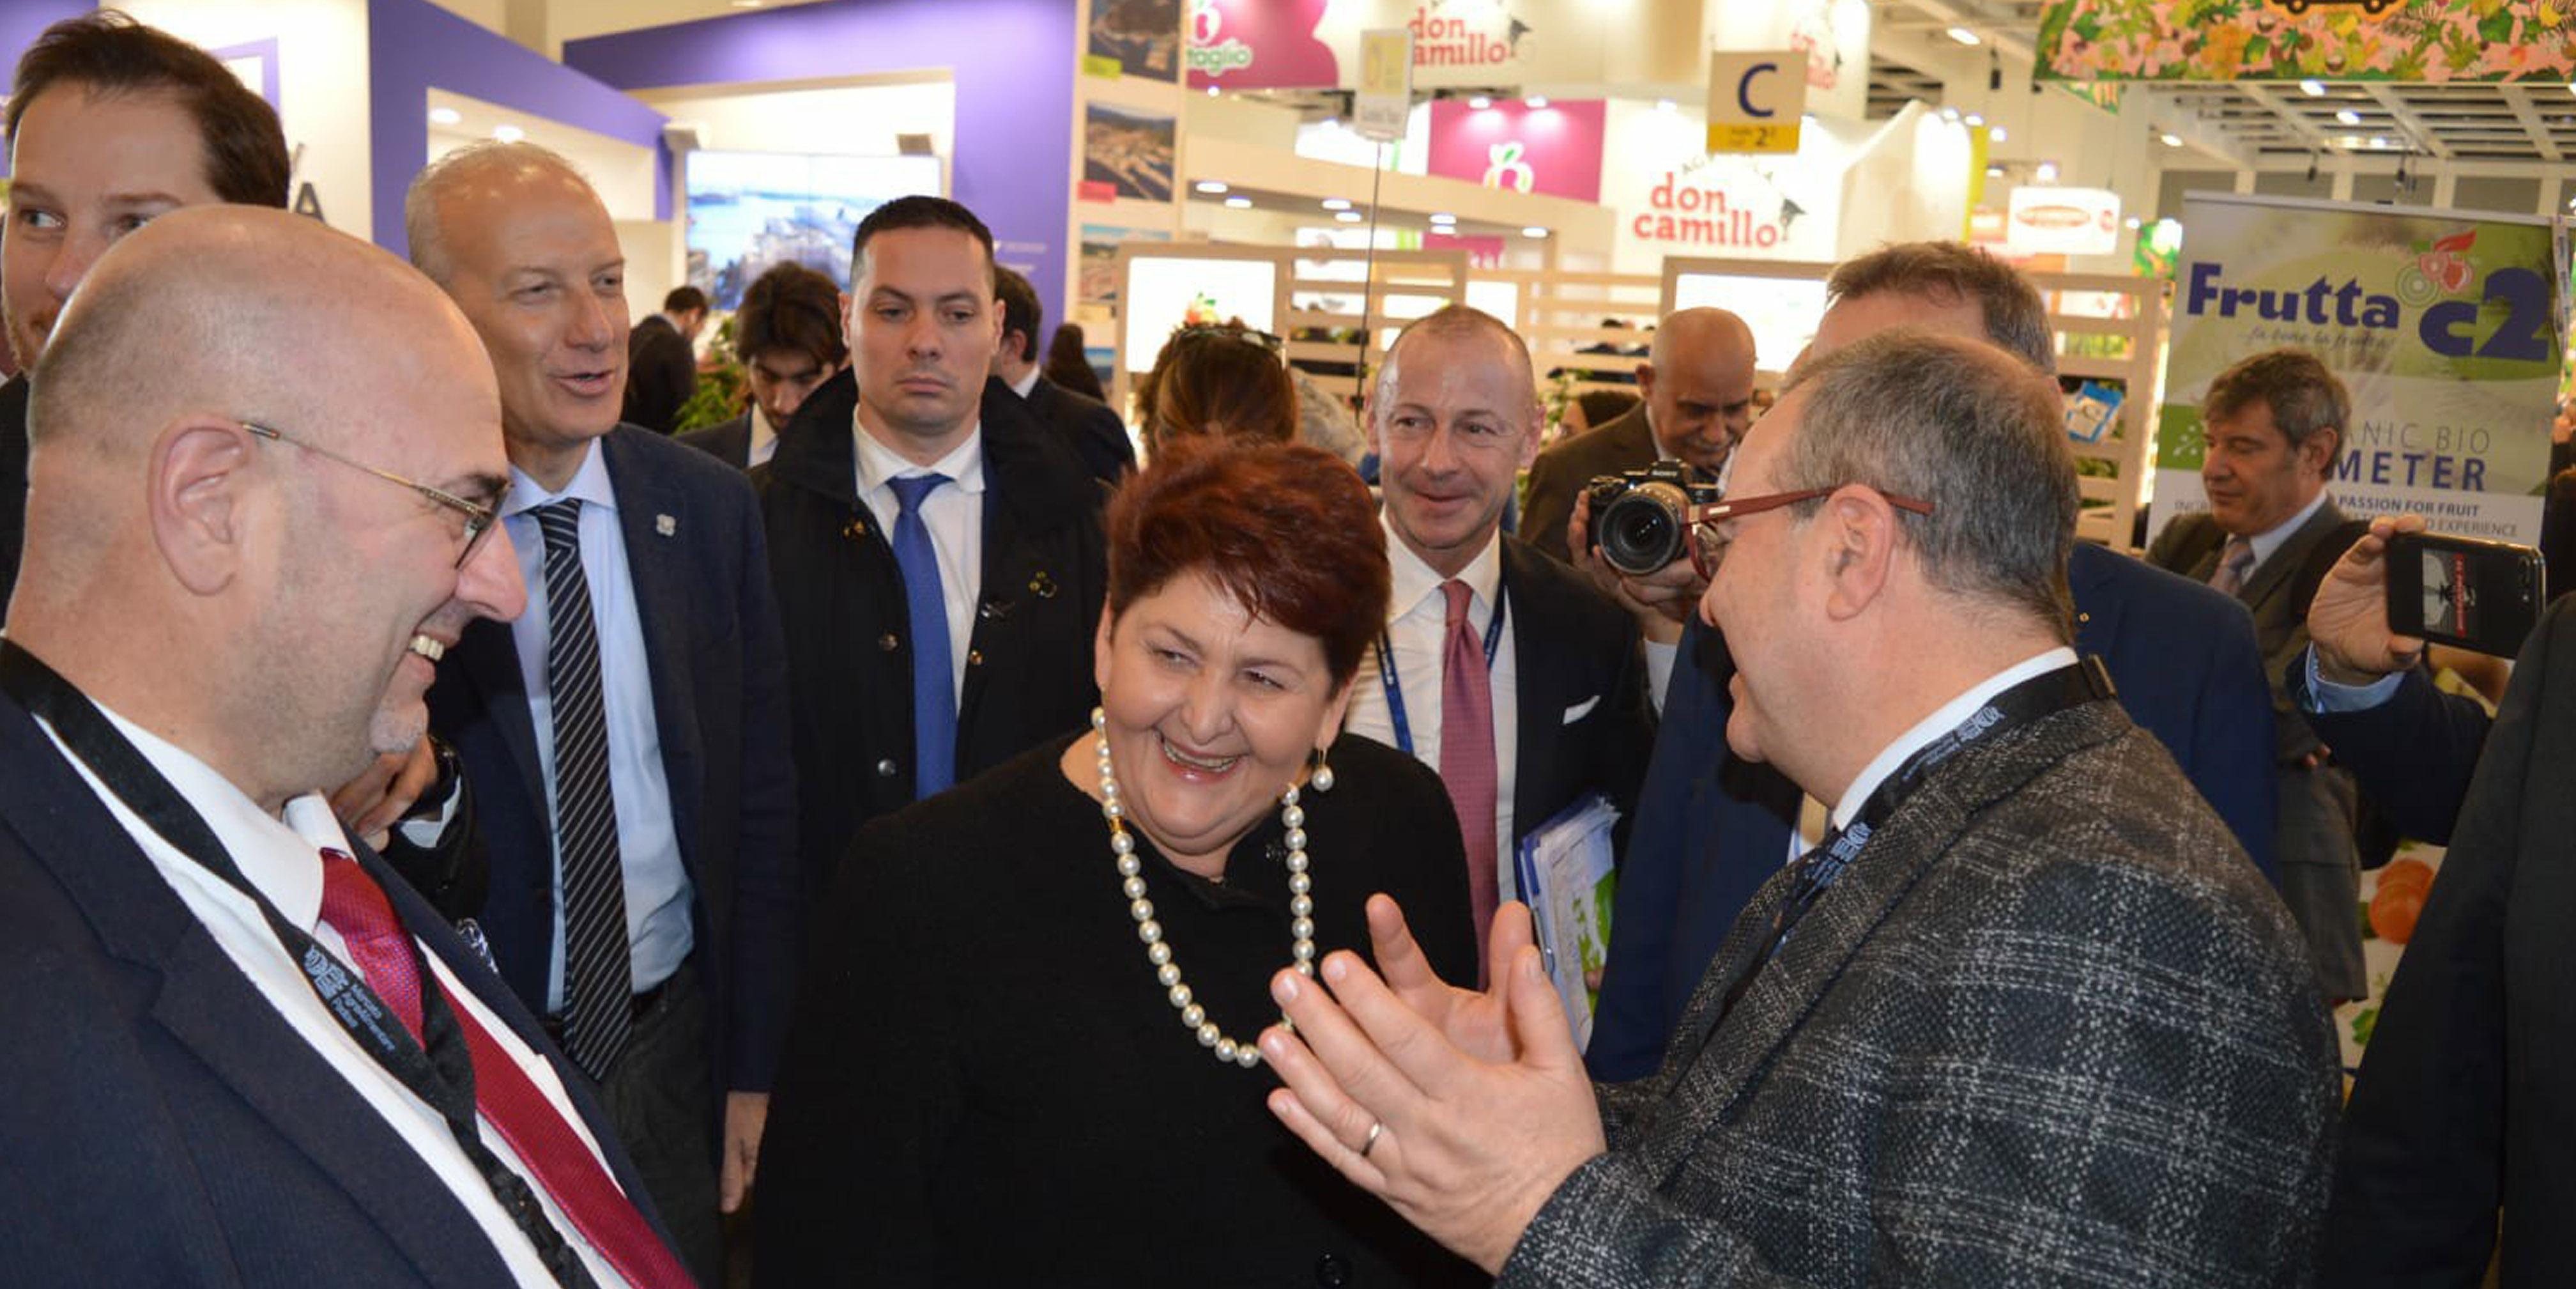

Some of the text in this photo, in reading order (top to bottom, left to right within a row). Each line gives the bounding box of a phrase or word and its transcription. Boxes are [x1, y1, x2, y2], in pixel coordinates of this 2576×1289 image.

[1407, 6, 1465, 40] don
[1186, 42, 1249, 72] taglio
[1413, 33, 1506, 66] amillo
[1738, 63, 1778, 118] C
[295, 181, 327, 224] A
[1650, 171, 1727, 214] don
[1633, 208, 1777, 248] camillo
[2188, 262, 2550, 362] Frutta c2
[2349, 421, 2490, 455] NIC BIO
[2338, 449, 2486, 492] METER
[2339, 495, 2480, 517] PASSION FOR FRUIT
[2438, 518, 2517, 537] EXPERIENCE
